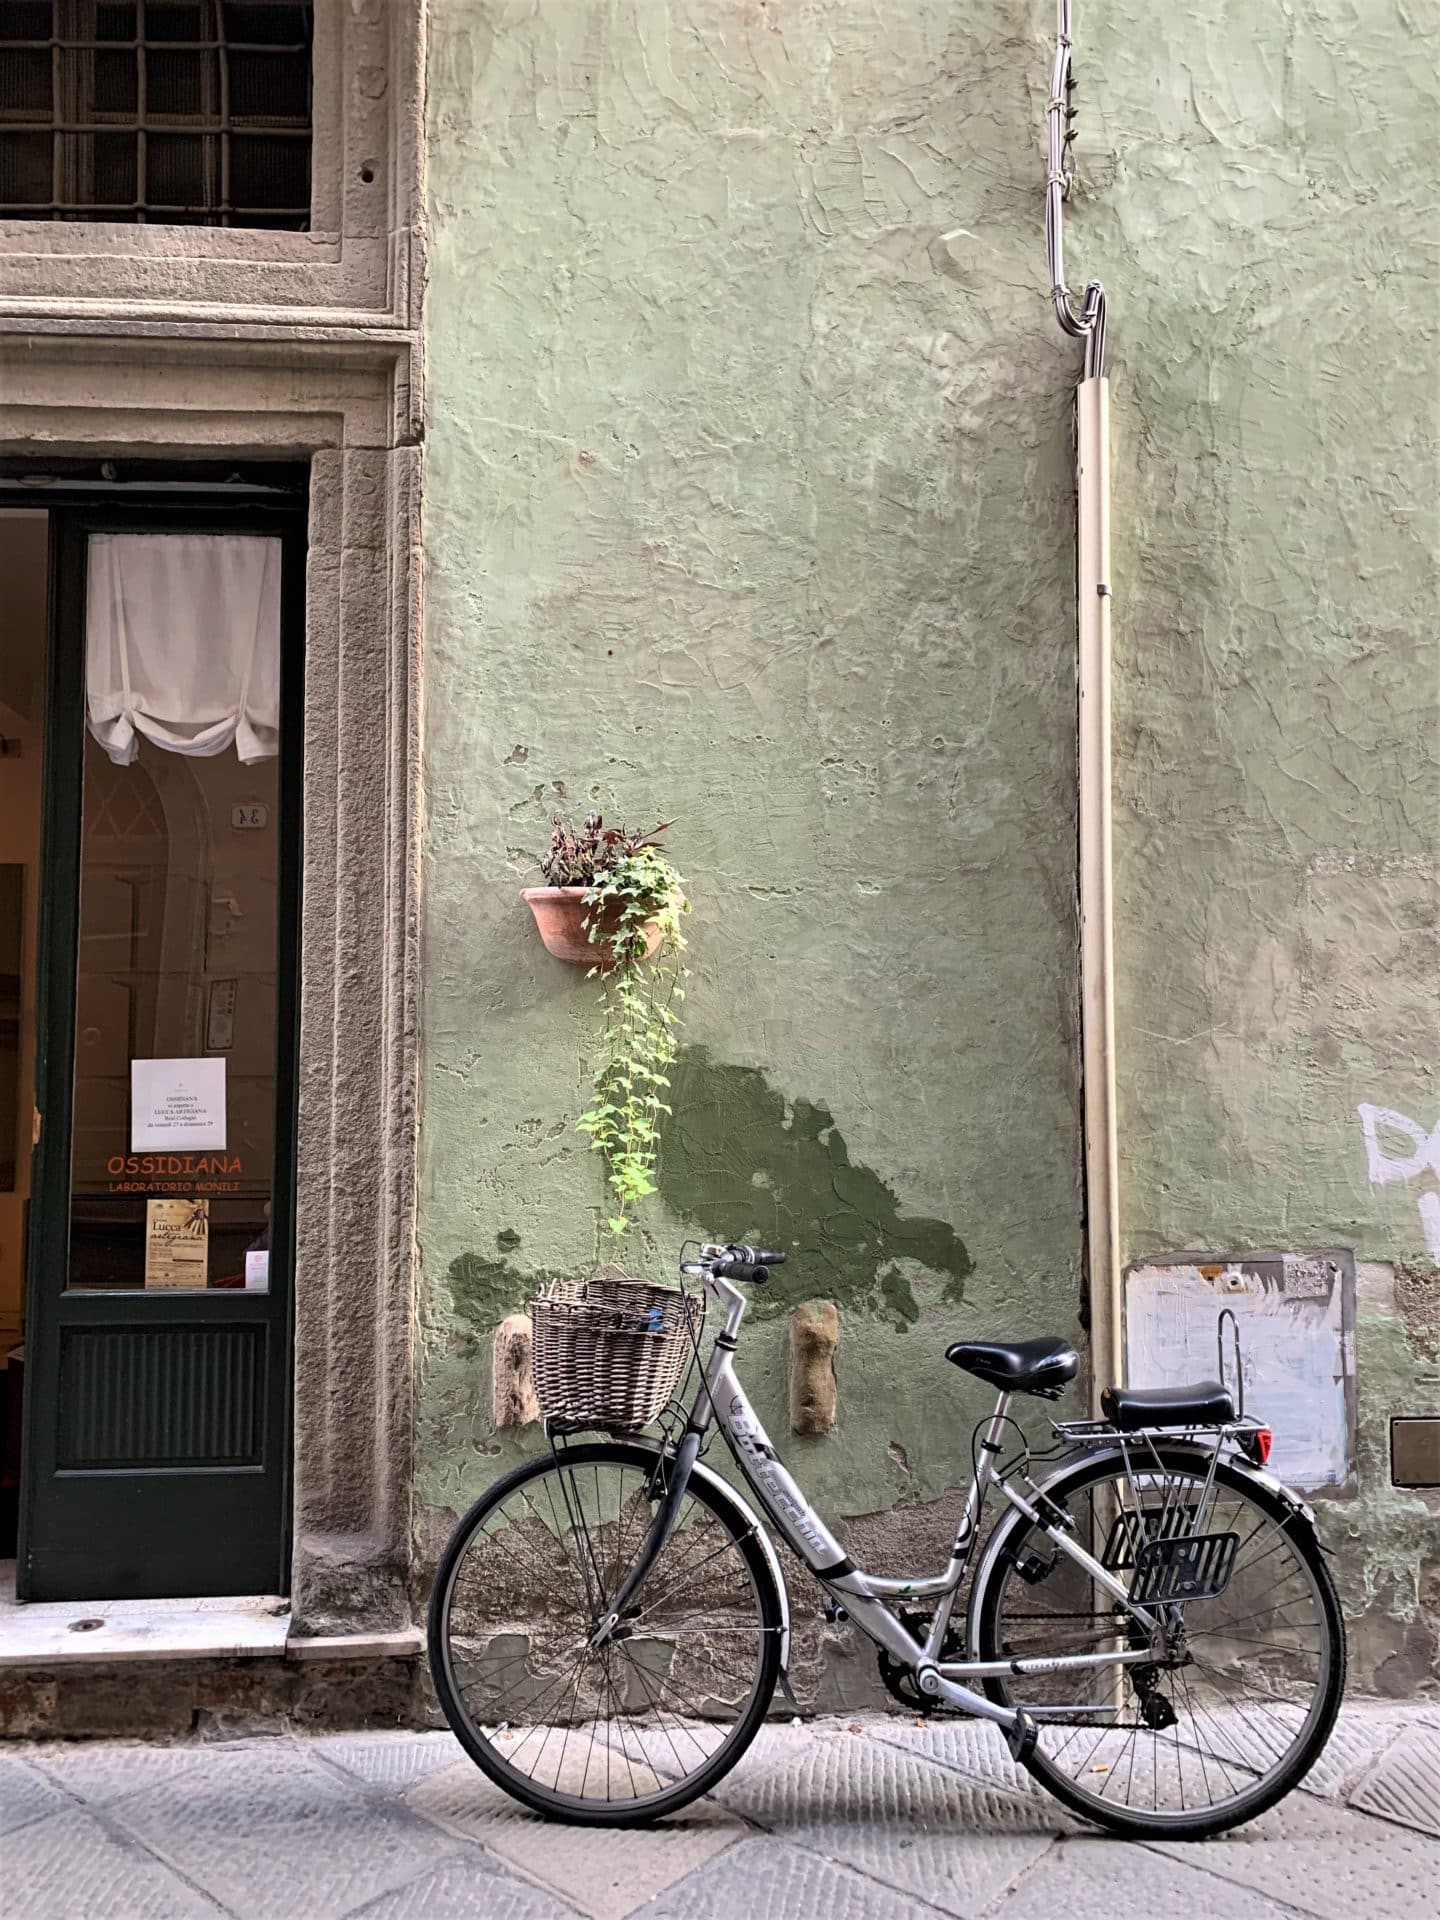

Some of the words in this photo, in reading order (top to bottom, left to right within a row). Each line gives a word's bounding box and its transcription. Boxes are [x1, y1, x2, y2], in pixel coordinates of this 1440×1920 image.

[107, 1156, 242, 1175] OSSIDIANA
[109, 1181, 192, 1193] LABORATORIO
[195, 1180, 241, 1192] MONILI
[152, 1222, 182, 1232] Lucca
